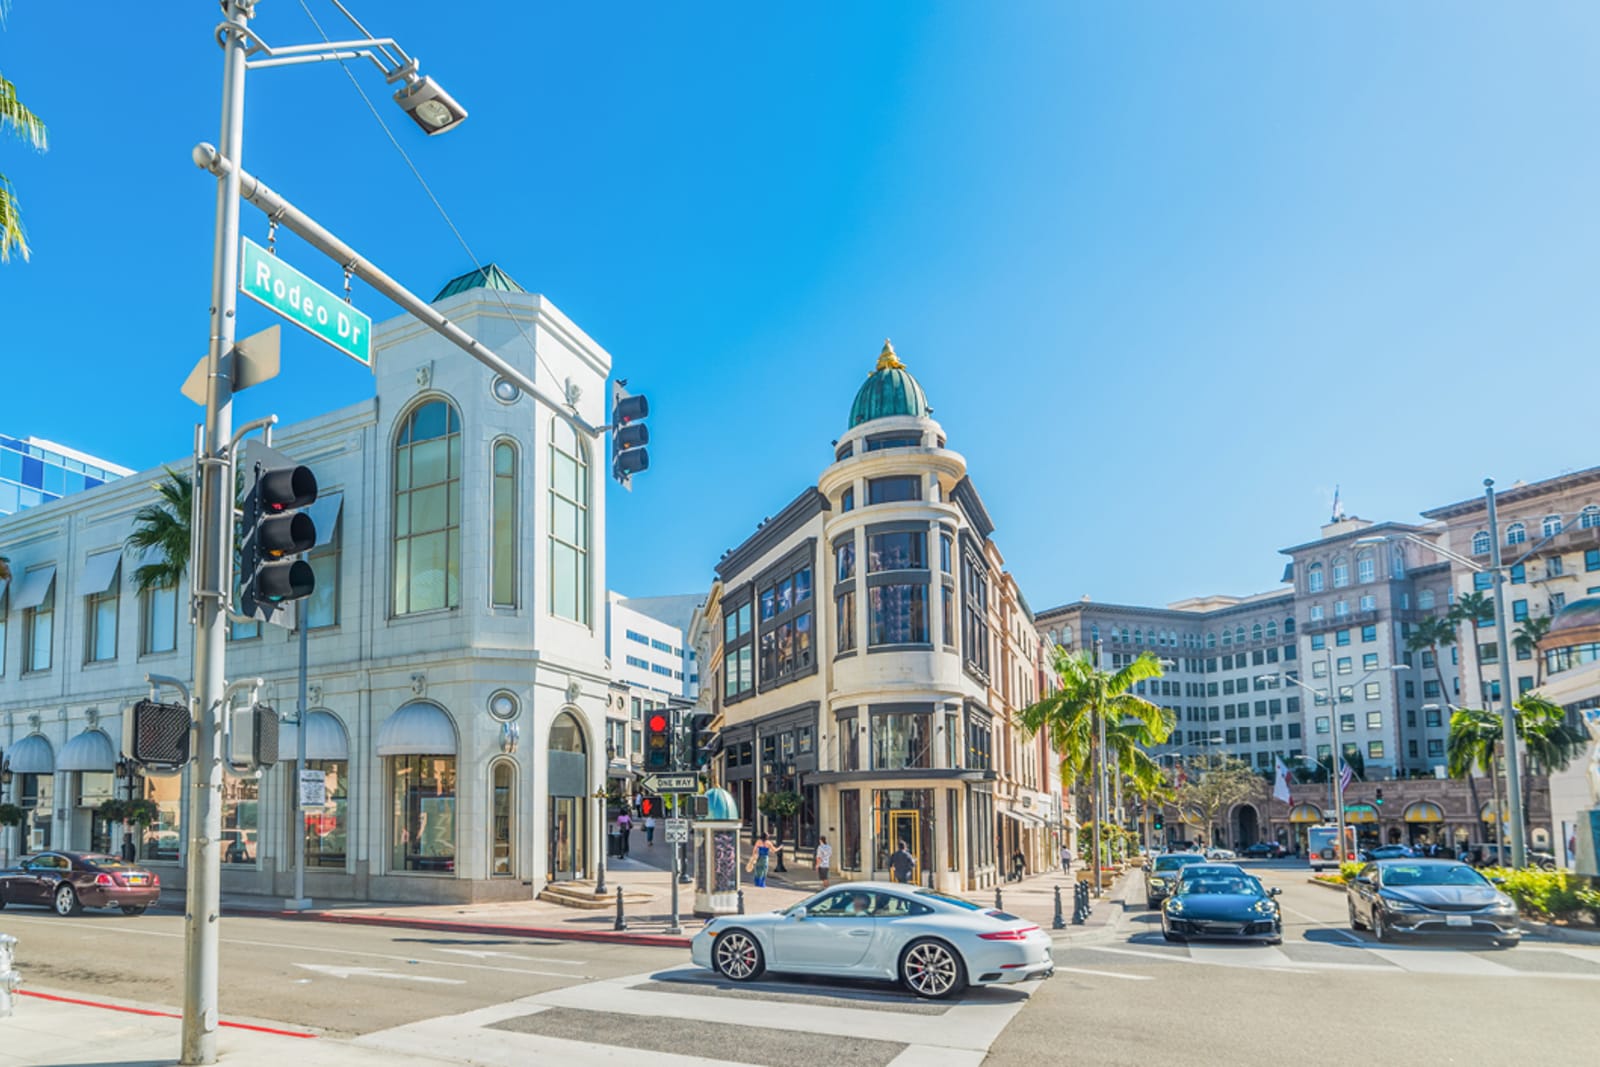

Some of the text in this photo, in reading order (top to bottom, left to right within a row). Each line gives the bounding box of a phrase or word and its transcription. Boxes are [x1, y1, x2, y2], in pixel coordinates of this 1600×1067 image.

[256, 262, 361, 345] Rodeo Dr
[658, 778, 691, 787] ONE WAY
